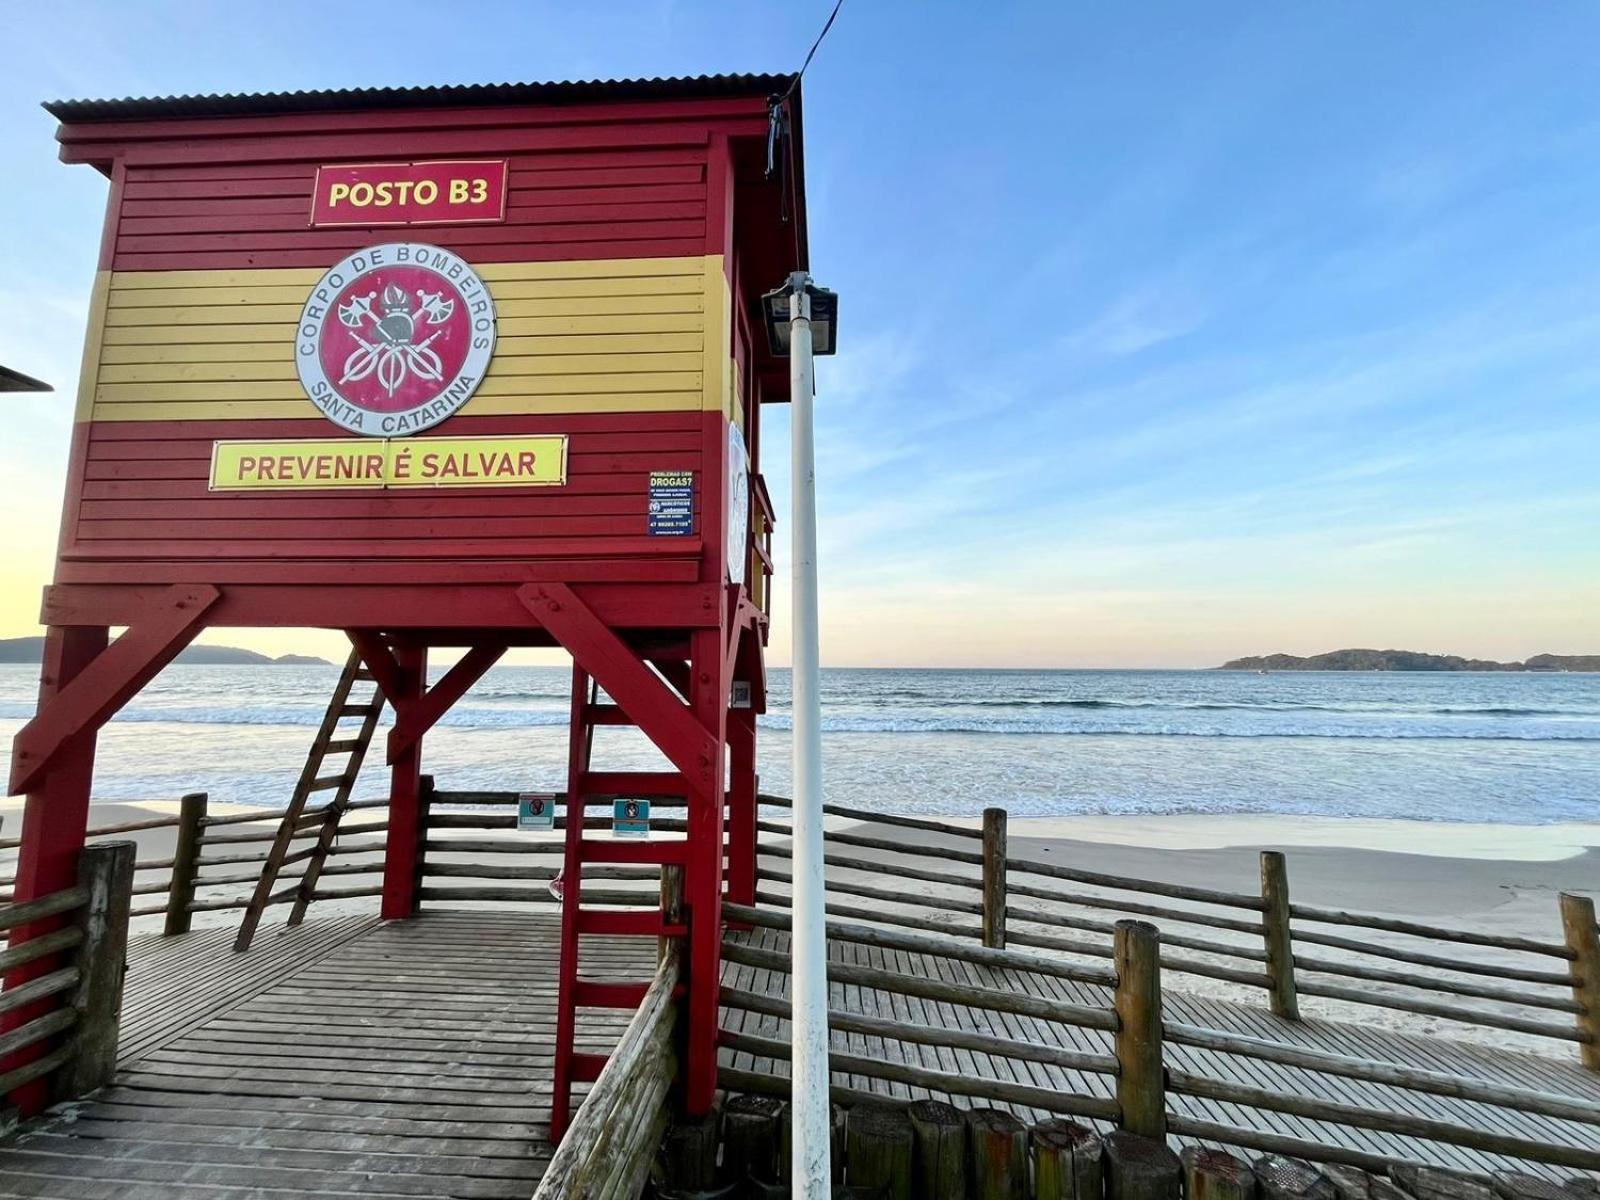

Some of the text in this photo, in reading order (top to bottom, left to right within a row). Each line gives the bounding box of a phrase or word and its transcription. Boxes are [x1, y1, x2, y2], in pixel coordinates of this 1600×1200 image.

[329, 178, 488, 207] POSTO B3
[300, 247, 491, 357] CORPO DE BOMBEIROS
[311, 375, 476, 433] SANTA CATARINA
[238, 447, 537, 481] PREVENIR É SALVAR
[650, 477, 692, 487] DROGAS?
